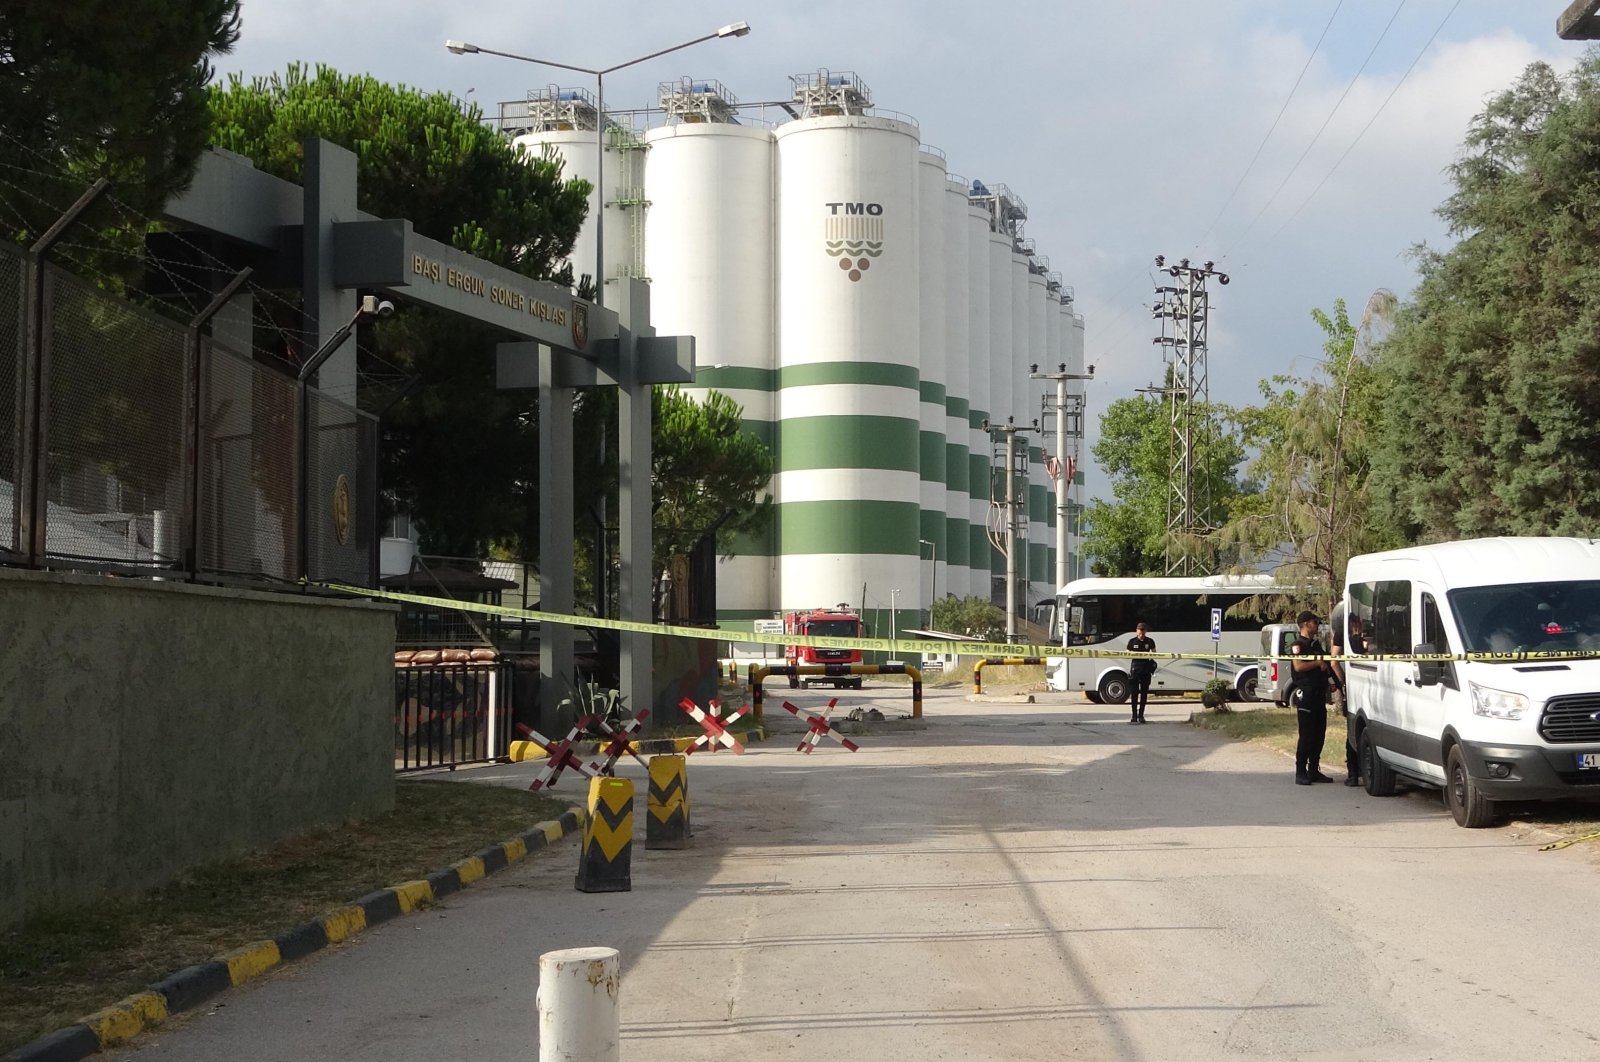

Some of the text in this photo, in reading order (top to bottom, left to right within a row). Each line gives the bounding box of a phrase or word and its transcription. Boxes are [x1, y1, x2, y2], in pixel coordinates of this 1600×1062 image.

[825, 202, 883, 216] TMO
[448, 268, 485, 297] ERGUN
[491, 286, 524, 311] SONER
[530, 298, 566, 326] KIŞLASI
[1584, 755, 1595, 766] 41
